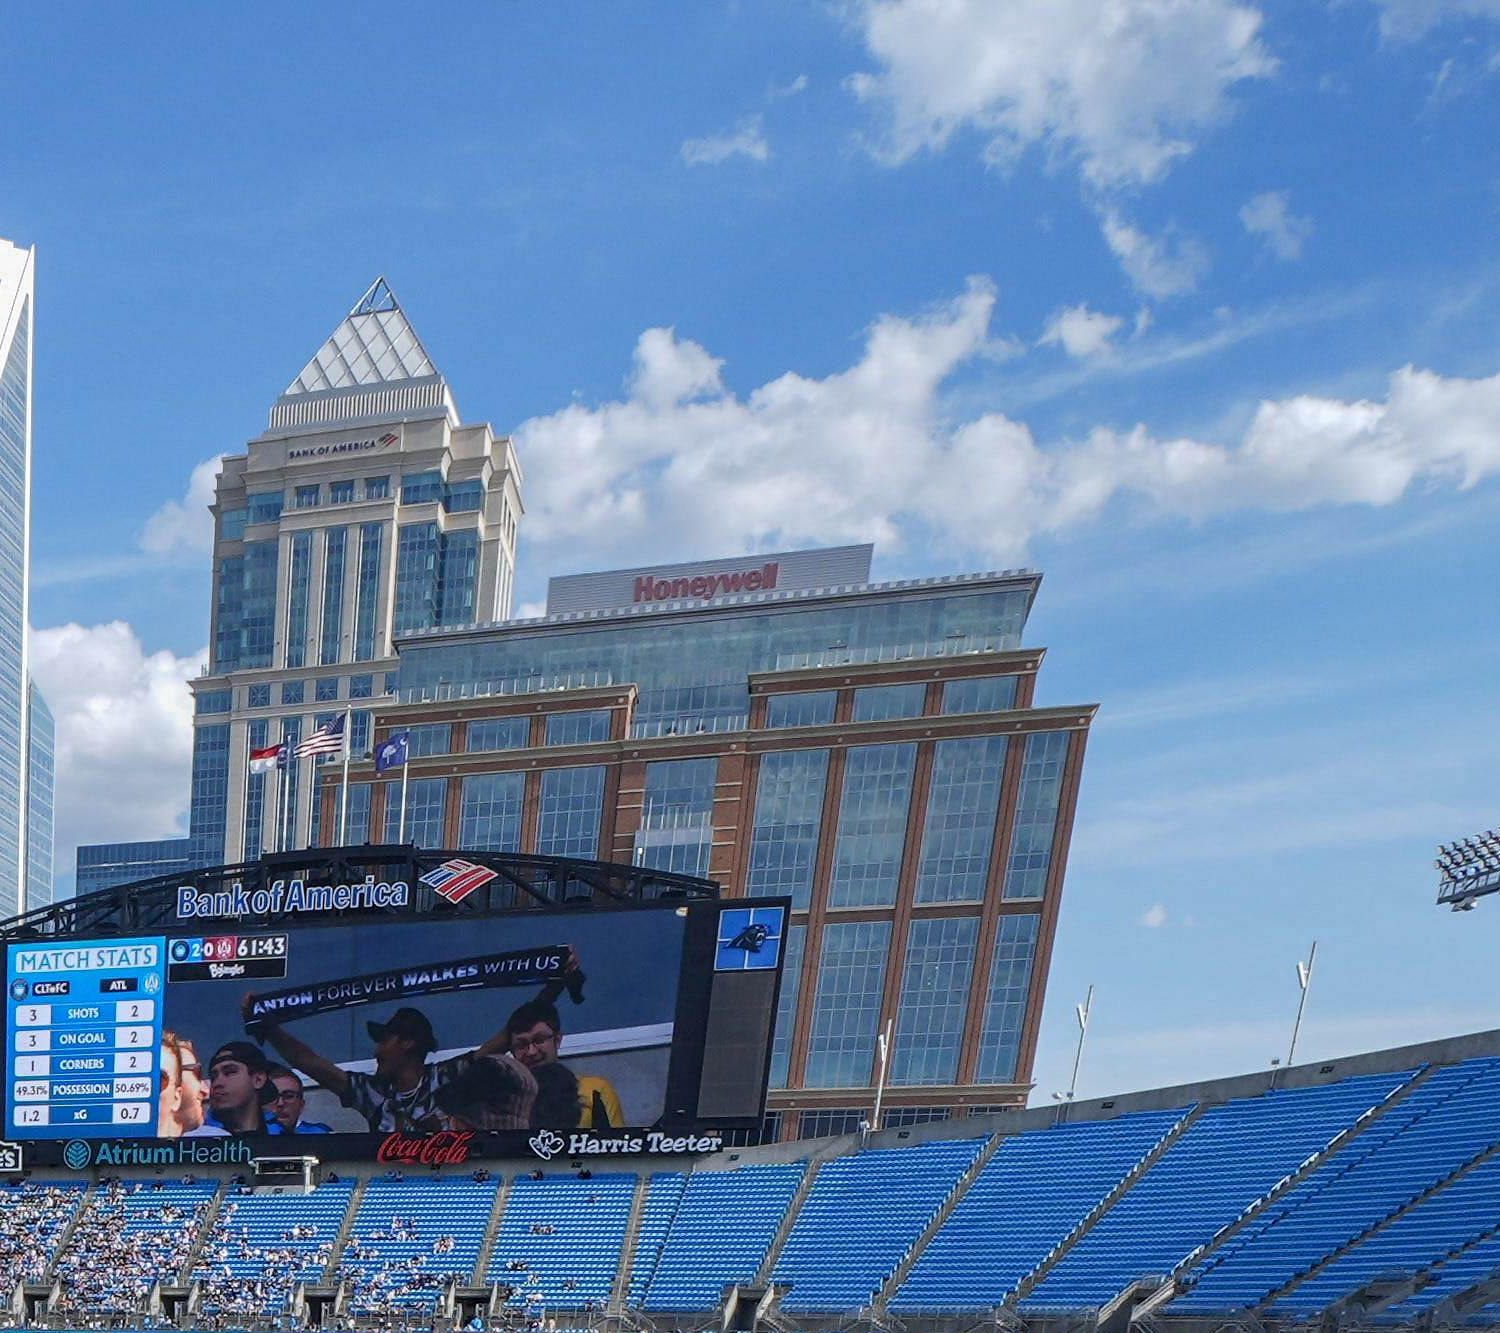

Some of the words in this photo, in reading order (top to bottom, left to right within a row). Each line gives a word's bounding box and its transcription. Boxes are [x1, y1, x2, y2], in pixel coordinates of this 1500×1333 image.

[633, 562, 779, 601] Honeywell
[176, 882, 249, 919] Bank
[251, 881, 285, 914] of
[284, 875, 409, 913] America
[237, 938, 285, 957] 61:43
[20, 951, 94, 971] MATCH
[96, 947, 152, 967] STATS
[109, 981, 127, 992] ATL
[252, 991, 313, 1016] ANTON
[316, 976, 397, 1002] FOREVER
[401, 964, 479, 988] WALKES
[484, 958, 531, 975] WITH
[534, 955, 560, 971] US
[29, 1009, 37, 1021] 3
[68, 1007, 99, 1019] SHOTS
[131, 1005, 139, 1018] 2
[29, 1035, 37, 1047] 3
[59, 1033, 76, 1045] ON
[76, 1032, 106, 1044] GOAL
[130, 1031, 138, 1043] 2
[59, 1058, 105, 1071] CORNERS
[130, 1057, 137, 1068] 2
[16, 1085, 48, 1096] 49.31%
[52, 1084, 111, 1096] POSSESSION
[114, 1082, 150, 1094] 50.69%
[23, 1110, 40, 1122] 1.2
[120, 1107, 140, 1120] 0.7
[95, 1140, 175, 1165] Atrium
[178, 1139, 250, 1164] Health
[567, 1133, 643, 1155] Harris
[647, 1132, 723, 1153] Teeter
